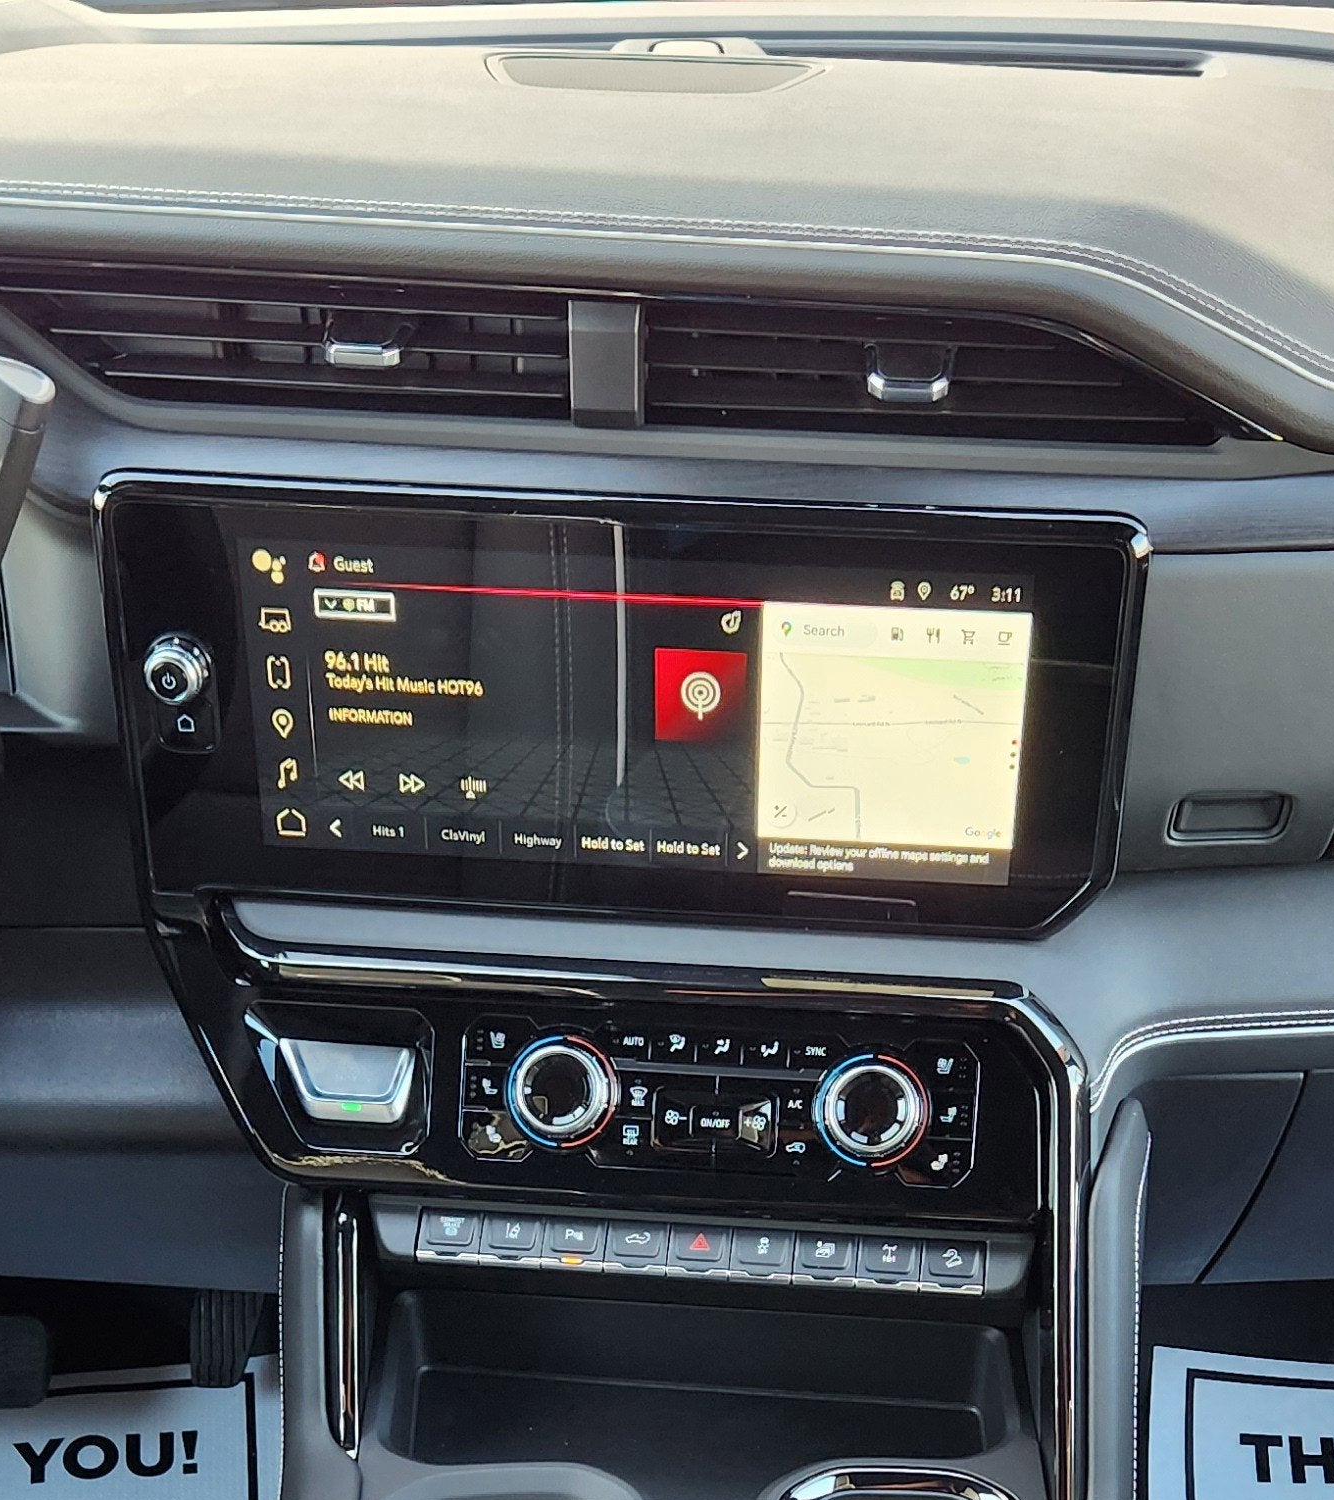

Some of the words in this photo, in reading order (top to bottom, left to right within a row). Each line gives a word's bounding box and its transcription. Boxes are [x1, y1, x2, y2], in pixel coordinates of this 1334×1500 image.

[333, 555, 375, 574] Guest
[990, 586, 1022, 603] 3:11
[803, 624, 845, 638] Search
[324, 650, 360, 672] 96.1
[363, 652, 390, 674] Hit
[325, 672, 374, 694] Today's
[375, 675, 396, 692] Hit
[396, 676, 436, 695] Music
[437, 678, 484, 698] HOT96
[328, 707, 413, 727] INFORMATION
[372, 825, 396, 838] Hits
[398, 826, 405, 838] 1
[965, 826, 1002, 840] Google
[514, 832, 563, 849] Highway
[581, 836, 609, 850] Hold
[610, 838, 624, 851] to
[625, 838, 646, 852] Set
[656, 840, 685, 854] Hold
[686, 842, 700, 855] to
[701, 843, 721, 856] Set
[622, 1035, 645, 1047] AUTO
[804, 1046, 828, 1058] SYNC
[787, 1099, 803, 1110] A/C
[700, 1117, 731, 1129] ON/OFF
[14, 1429, 199, 1480] YOU!
